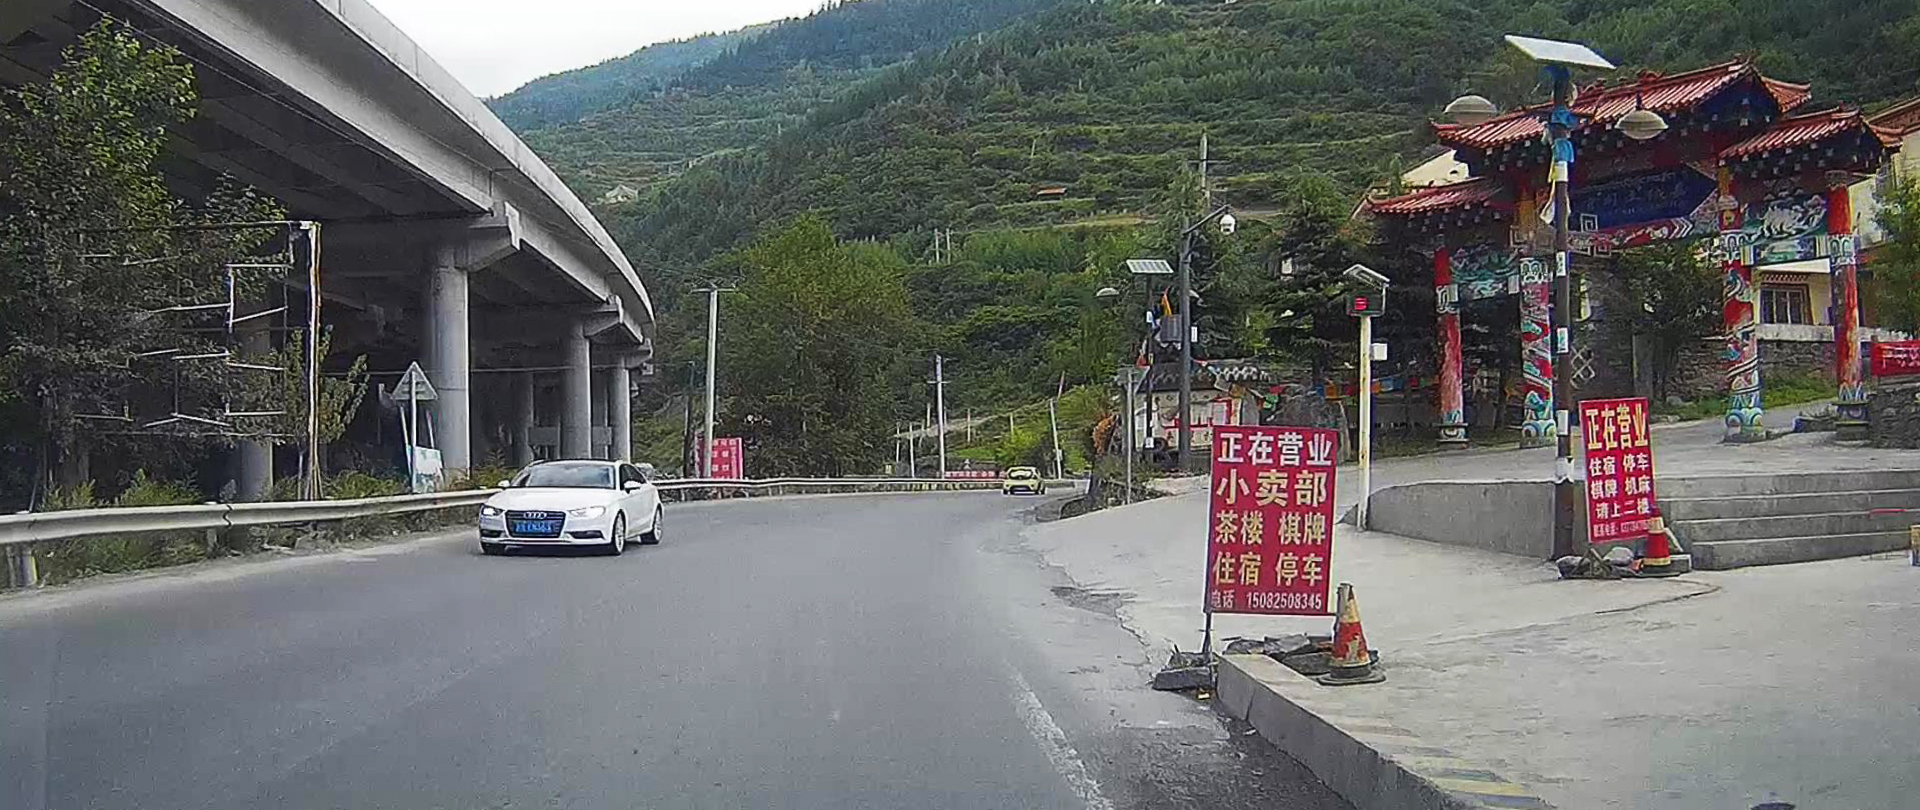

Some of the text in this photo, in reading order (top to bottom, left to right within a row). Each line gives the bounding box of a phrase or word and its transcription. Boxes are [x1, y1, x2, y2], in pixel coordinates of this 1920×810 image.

[1586, 403, 1648, 451] 正在营业
[1217, 431, 1332, 467] 正在营业
[1589, 453, 1649, 476] 住宿 停车
[1216, 468, 1327, 508] 小卖部
[1590, 475, 1651, 499] 棋牌 机麻
[1596, 498, 1650, 519] 请上二楼
[1215, 510, 1326, 545] 茶楼 棋牌
[1213, 551, 1323, 587] 住宿 停车
[1211, 589, 1322, 609] 电话 15082508345
